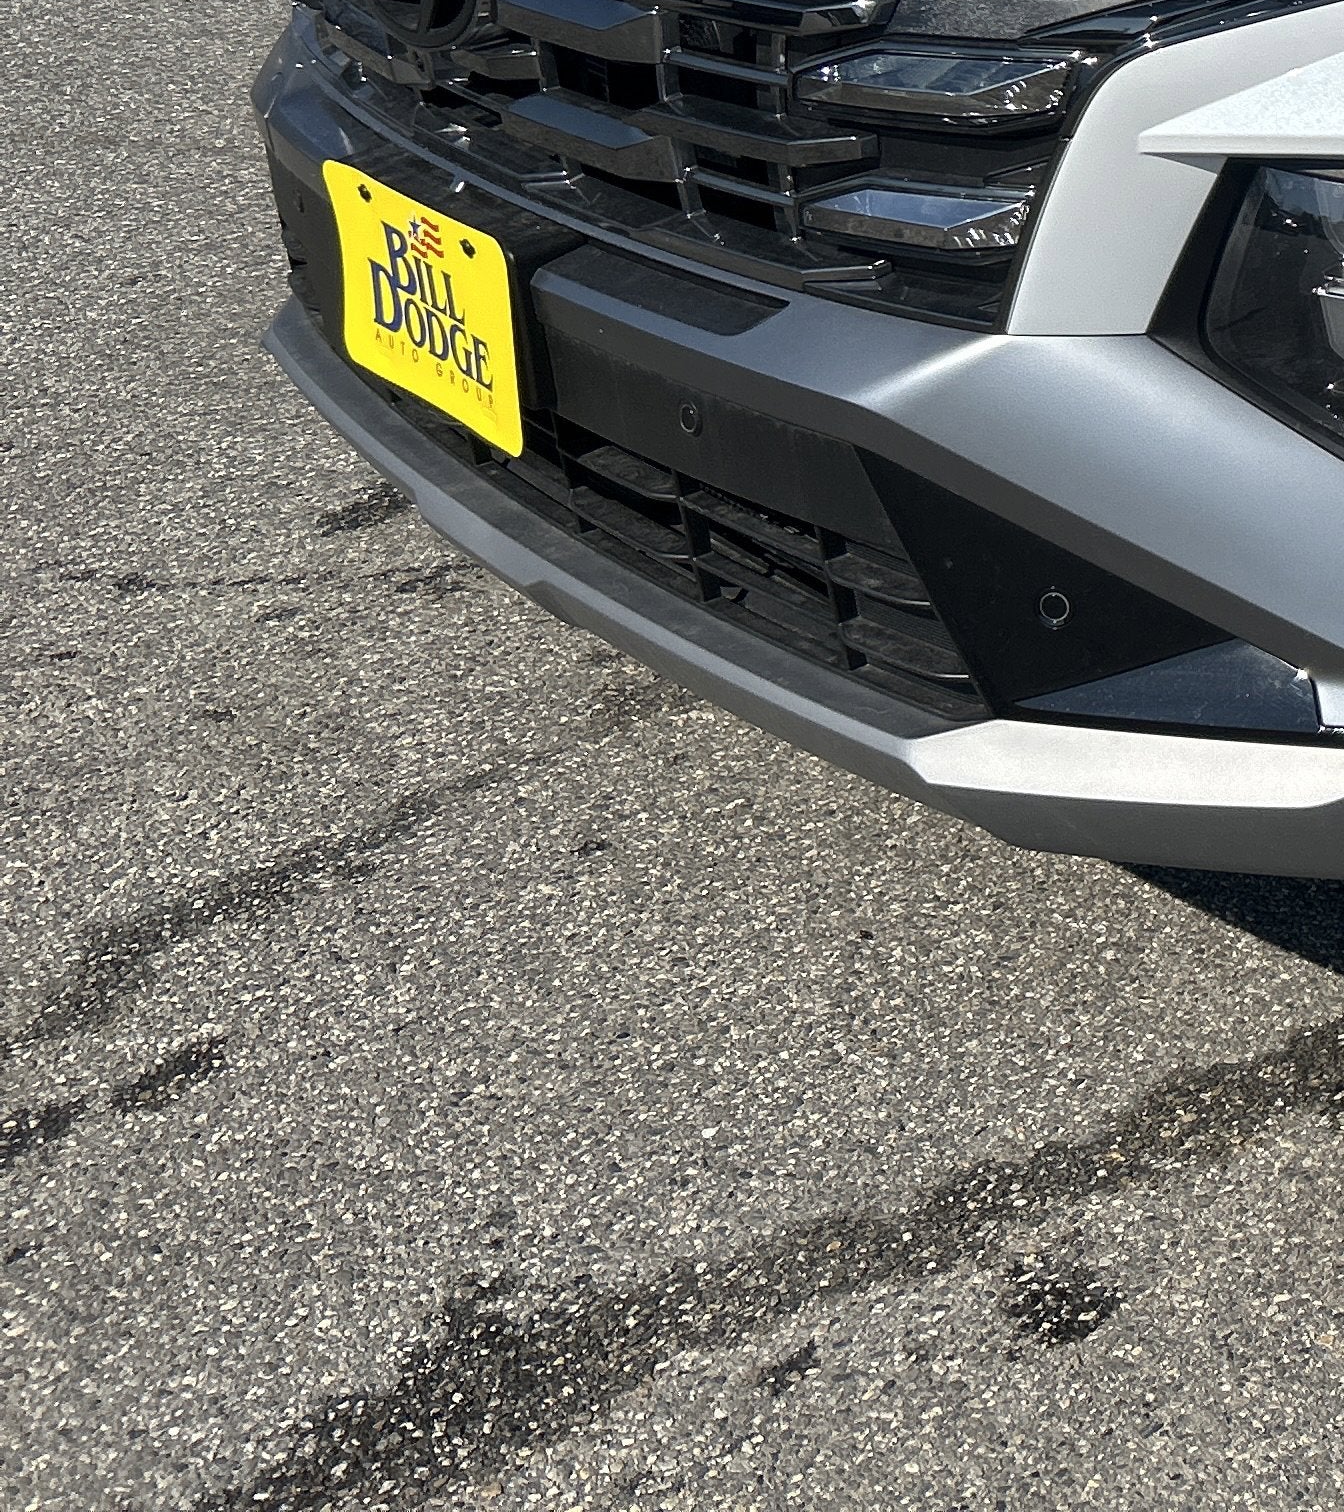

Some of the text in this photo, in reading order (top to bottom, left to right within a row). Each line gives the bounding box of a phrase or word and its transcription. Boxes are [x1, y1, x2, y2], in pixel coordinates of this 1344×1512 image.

[367, 257, 493, 392] DODGE
[381, 221, 466, 326] BILL
[375, 327, 495, 409] AUTO GROUP
